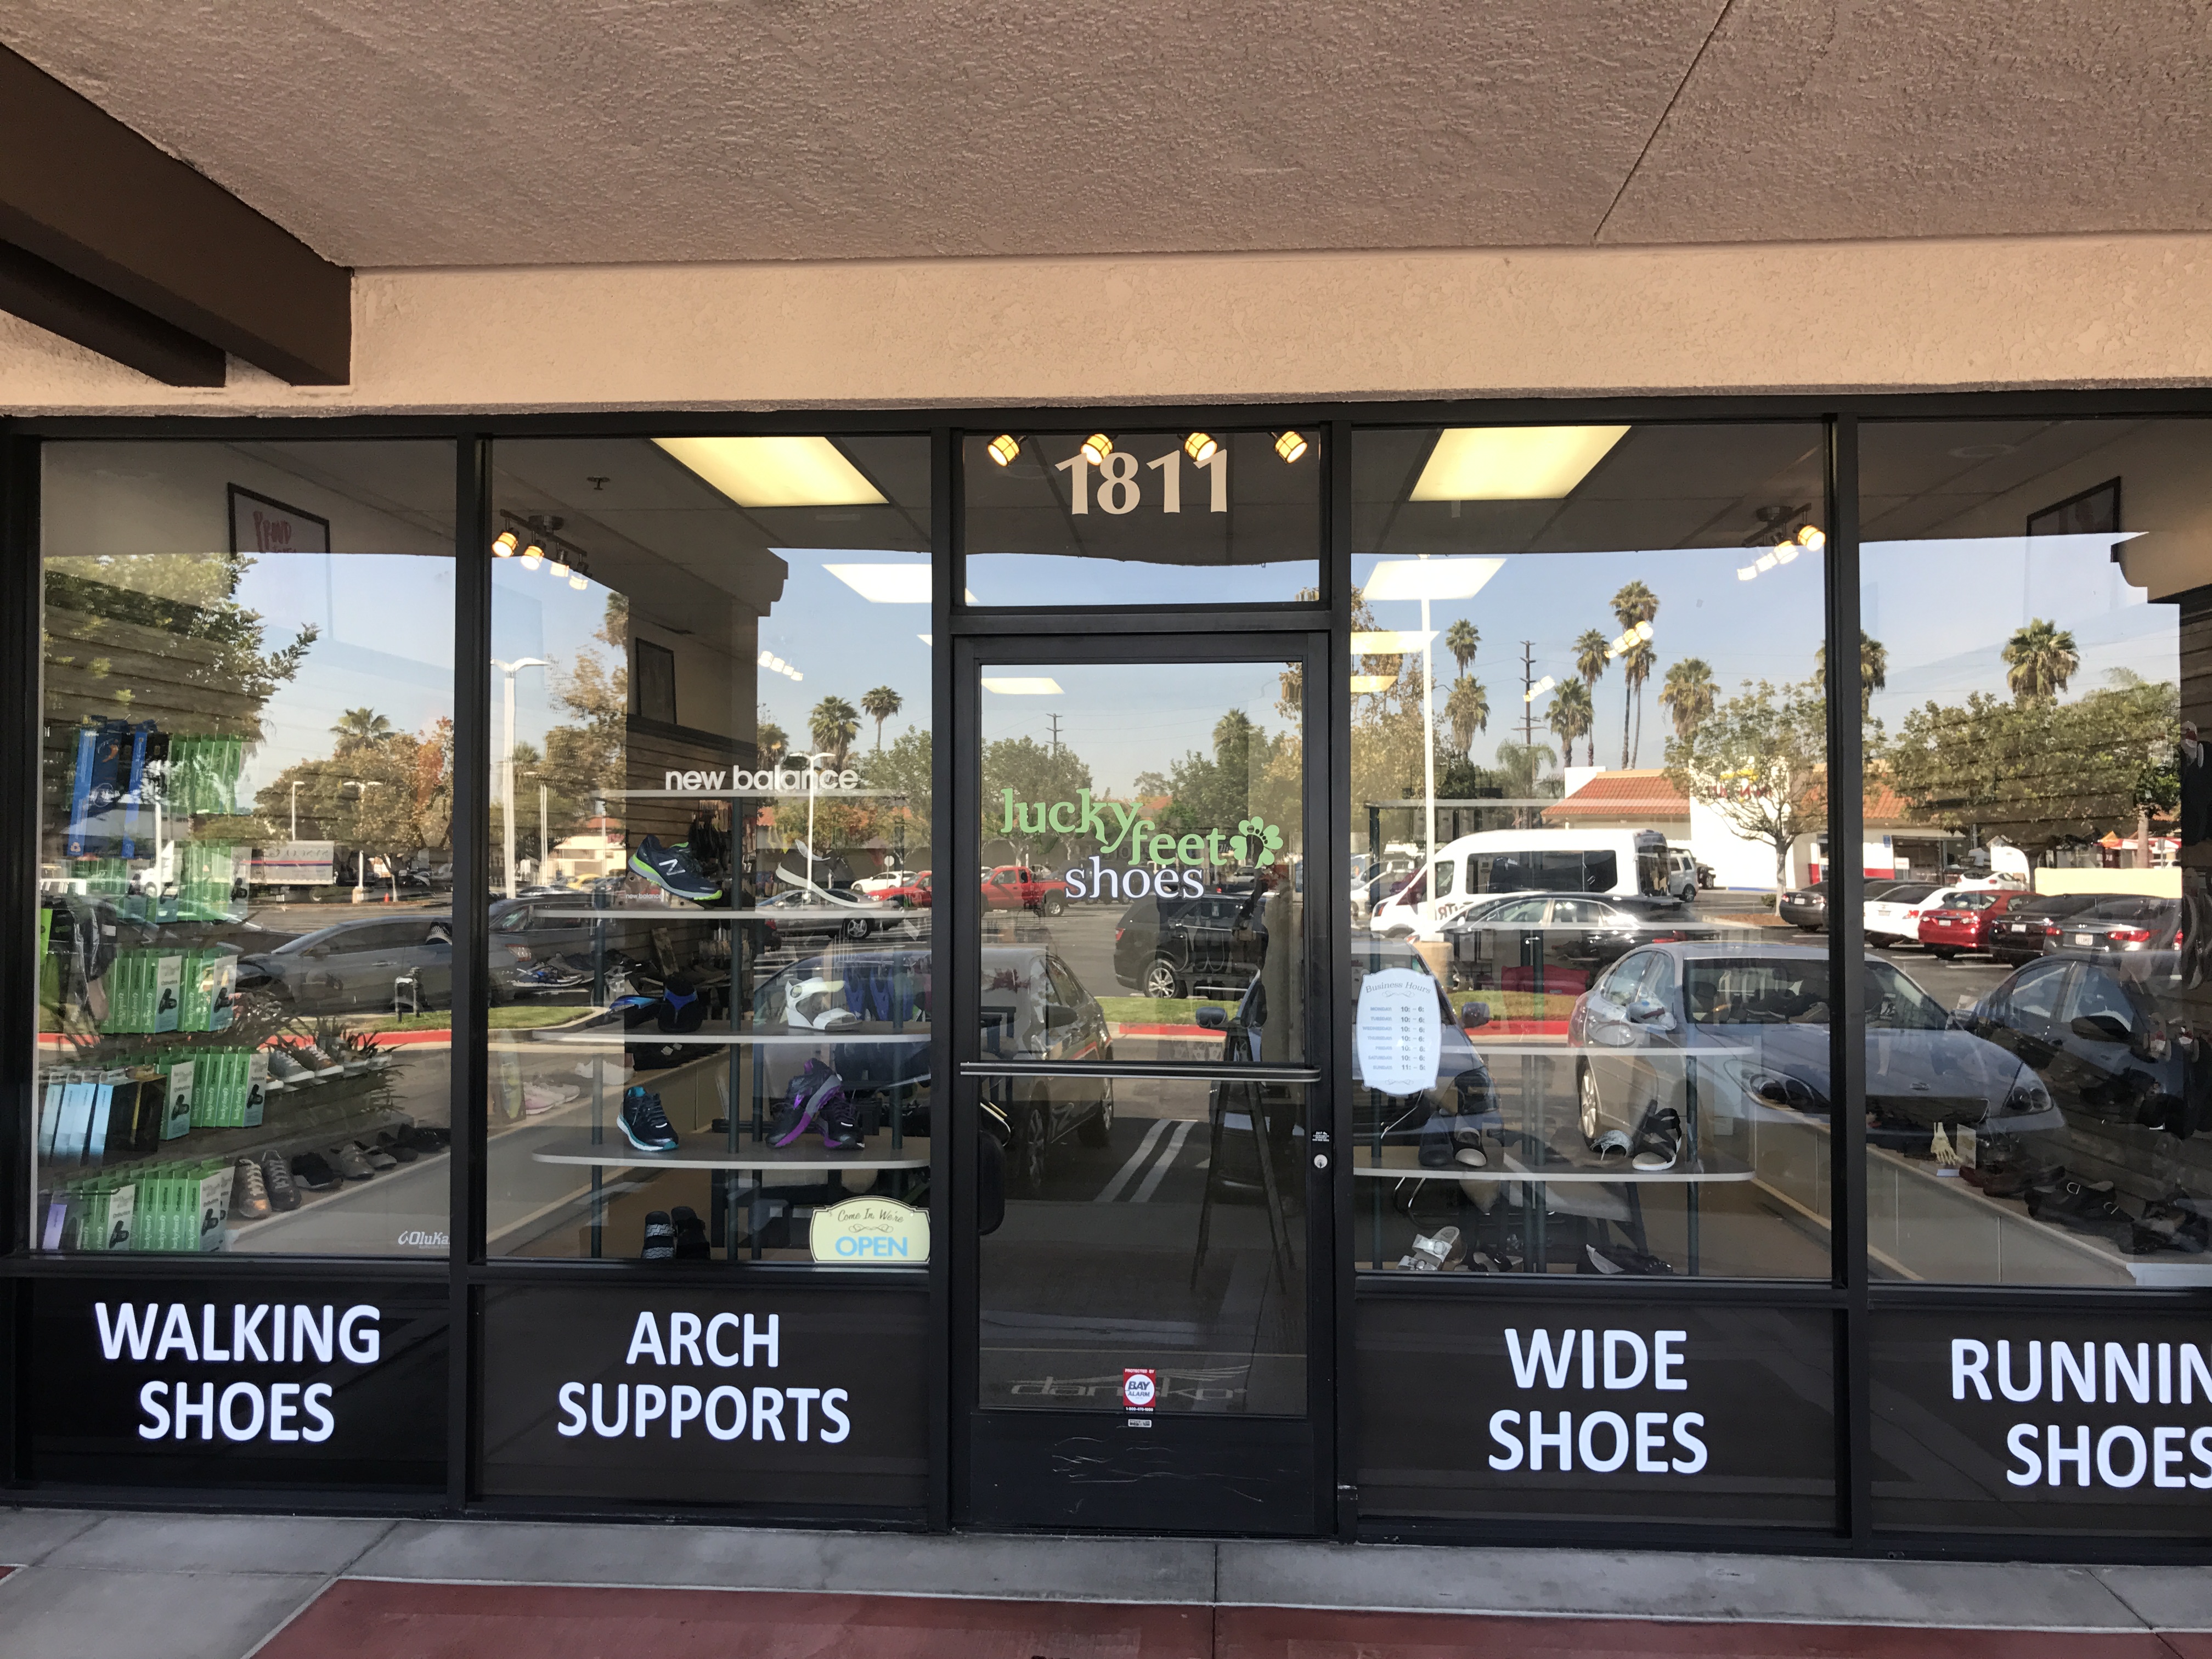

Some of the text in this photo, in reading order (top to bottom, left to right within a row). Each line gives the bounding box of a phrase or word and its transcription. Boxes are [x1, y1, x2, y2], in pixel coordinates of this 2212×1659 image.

[1055, 449, 1228, 515] 1811
[664, 765, 859, 791] new balance
[1000, 788, 1143, 854] lucky
[1128, 820, 1227, 866] feet
[1065, 856, 1205, 899] shoes
[1365, 981, 1431, 994] Business Hours
[408, 1231, 450, 1245] OluKa
[837, 1209, 861, 1222] Come
[879, 1209, 904, 1223] We're
[835, 1236, 908, 1256] OPEN
[94, 1302, 380, 1364] WALKING
[626, 1311, 779, 1368] ARCH
[1011, 1365, 1234, 1401] danko
[1504, 1328, 1688, 1391] WIDE
[138, 1380, 335, 1442] SHOES
[1128, 1381, 1151, 1390] BAY
[557, 1381, 851, 1443] SUPPORTS
[1488, 1409, 1708, 1474] SHOES
[2006, 1423, 2212, 1489] SHOES
